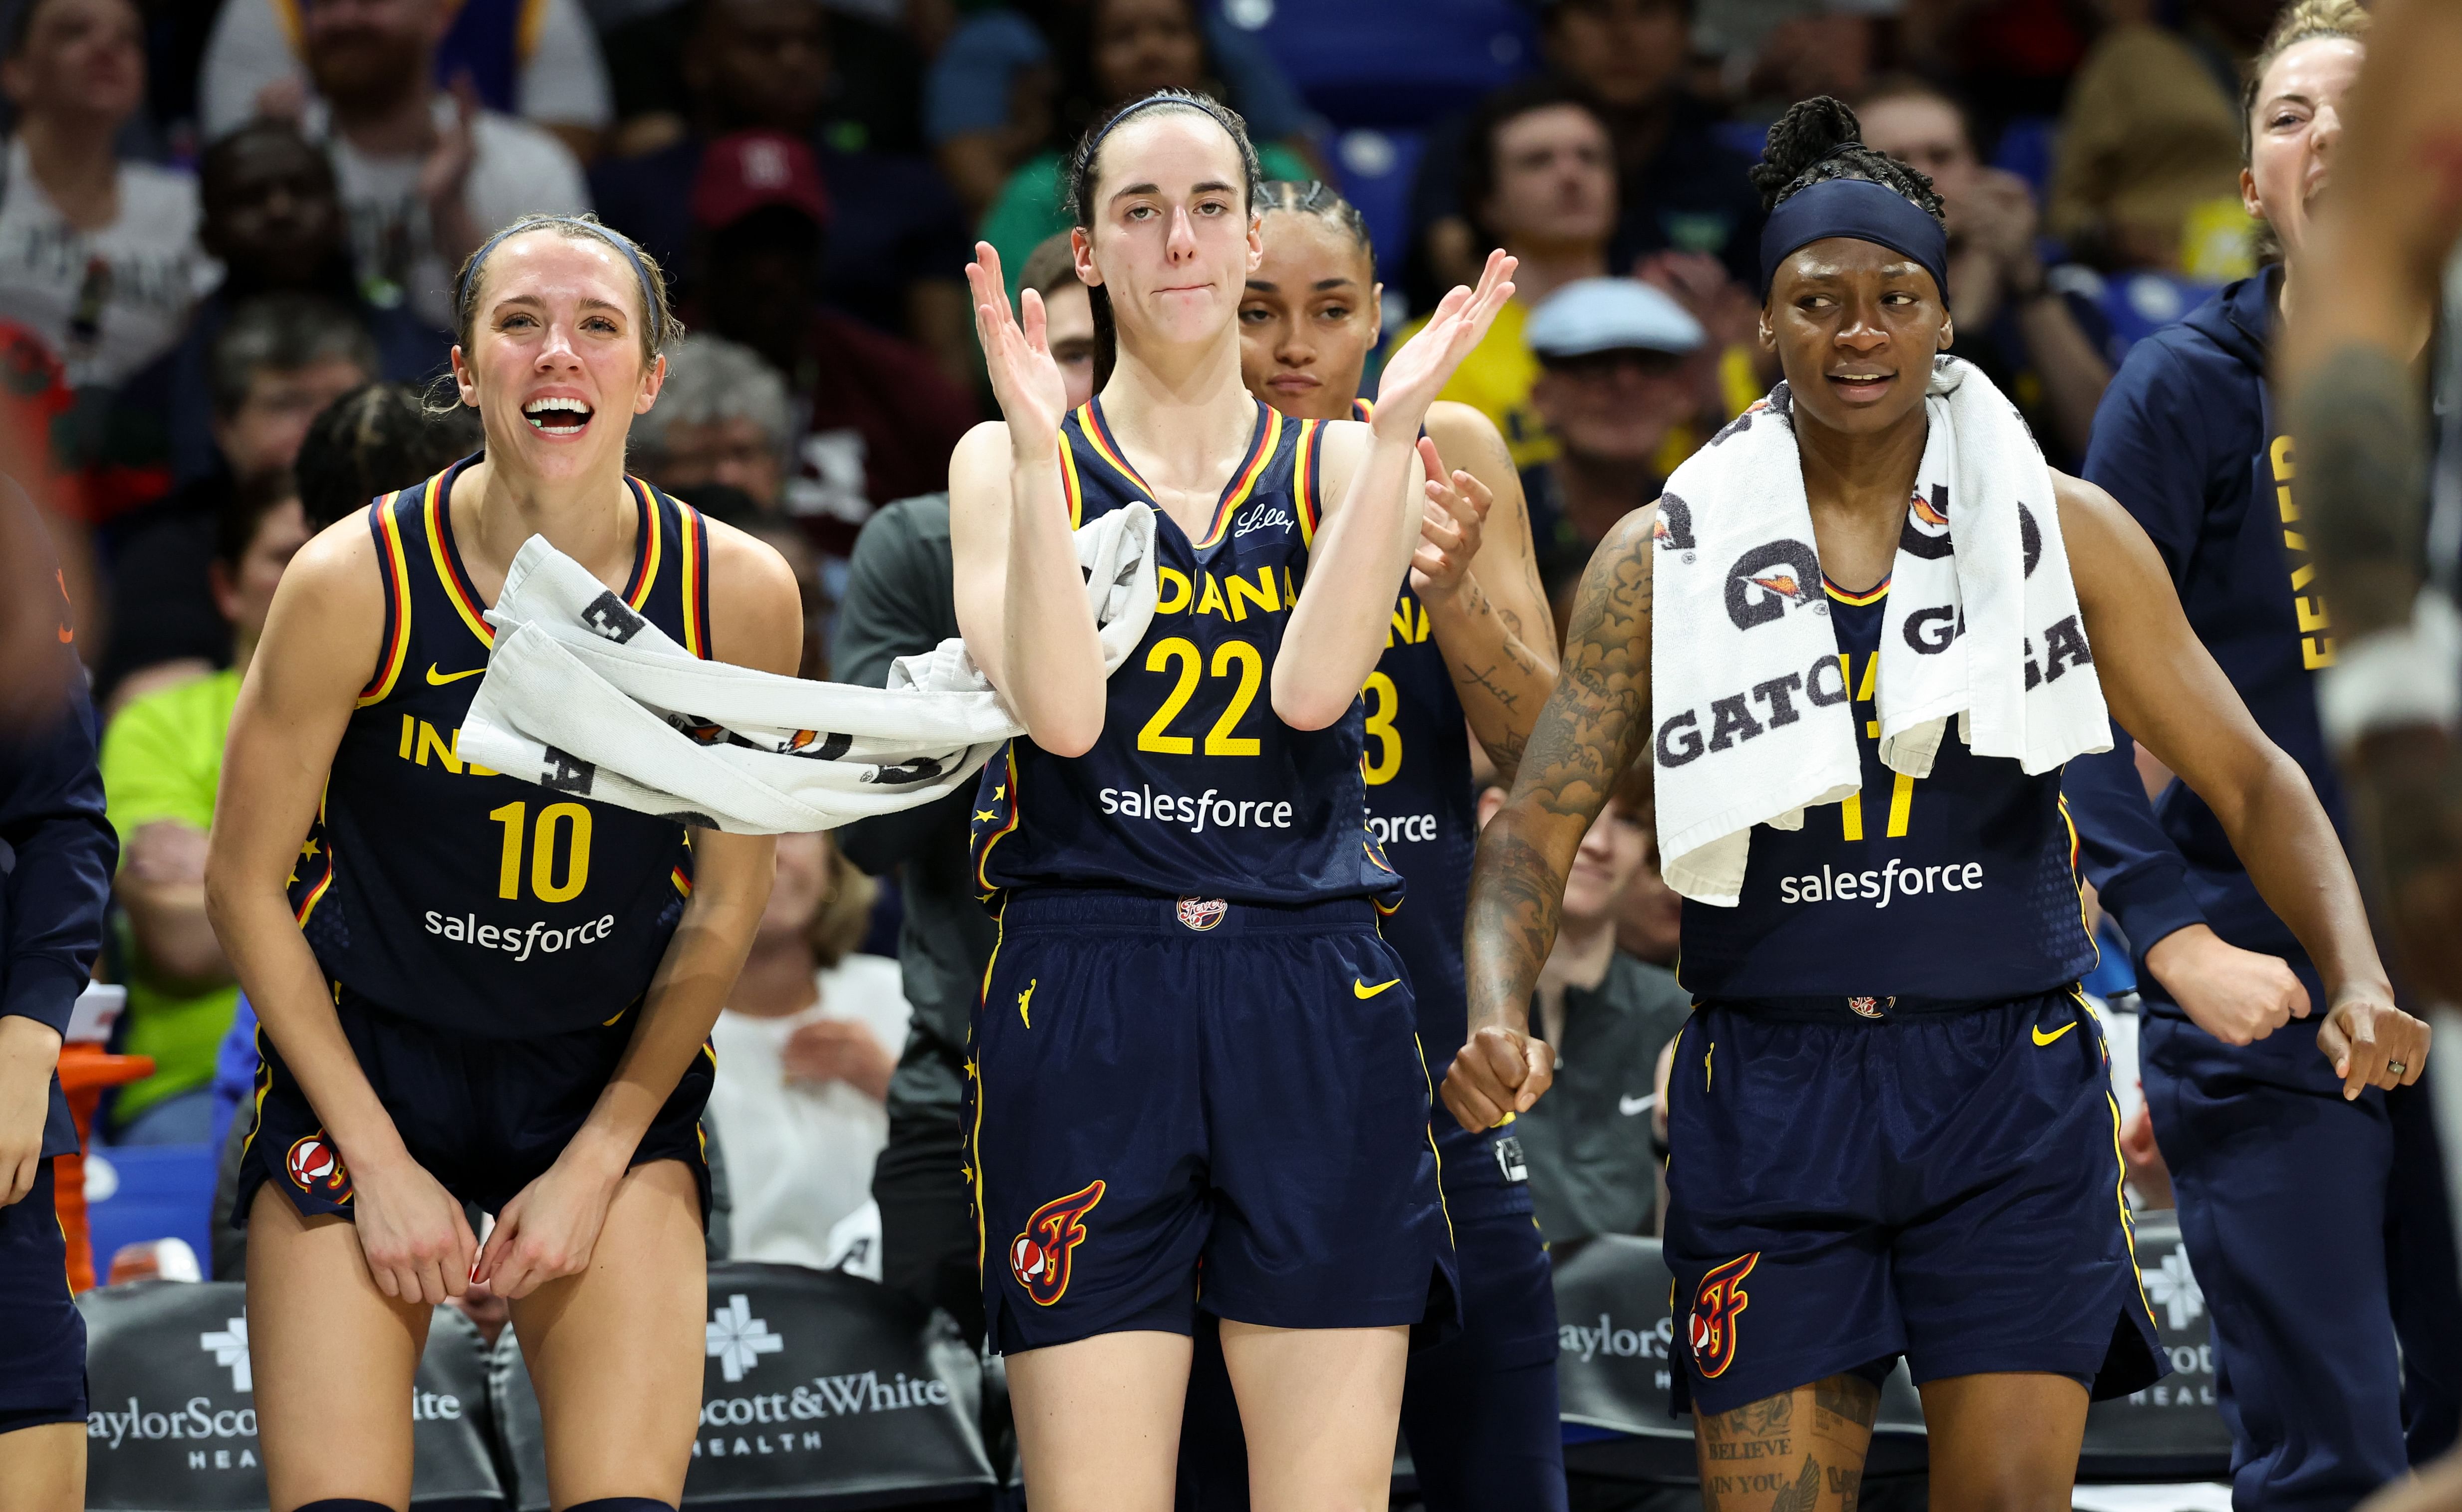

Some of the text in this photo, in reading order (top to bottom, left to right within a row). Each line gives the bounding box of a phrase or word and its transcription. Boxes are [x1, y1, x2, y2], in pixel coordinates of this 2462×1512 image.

[1234, 503, 1294, 538] Lilly
[1903, 604, 1966, 654] G
[1137, 637, 1263, 756] 22
[1656, 654, 1848, 768] GATO
[399, 713, 502, 776] IN
[1099, 784, 1292, 833] salesforce
[1364, 807, 1437, 844] orce
[490, 801, 592, 903] 10
[1179, 896, 1227, 920] Fever
[1780, 859, 1983, 908] salesforce
[425, 910, 614, 961] salesforce
[699, 1370, 949, 1427] cott&White
[188, 1449, 257, 1469] HEA
[1709, 1439, 1793, 1461] BELIEVE
[1714, 1473, 1782, 1494] IN YOU
